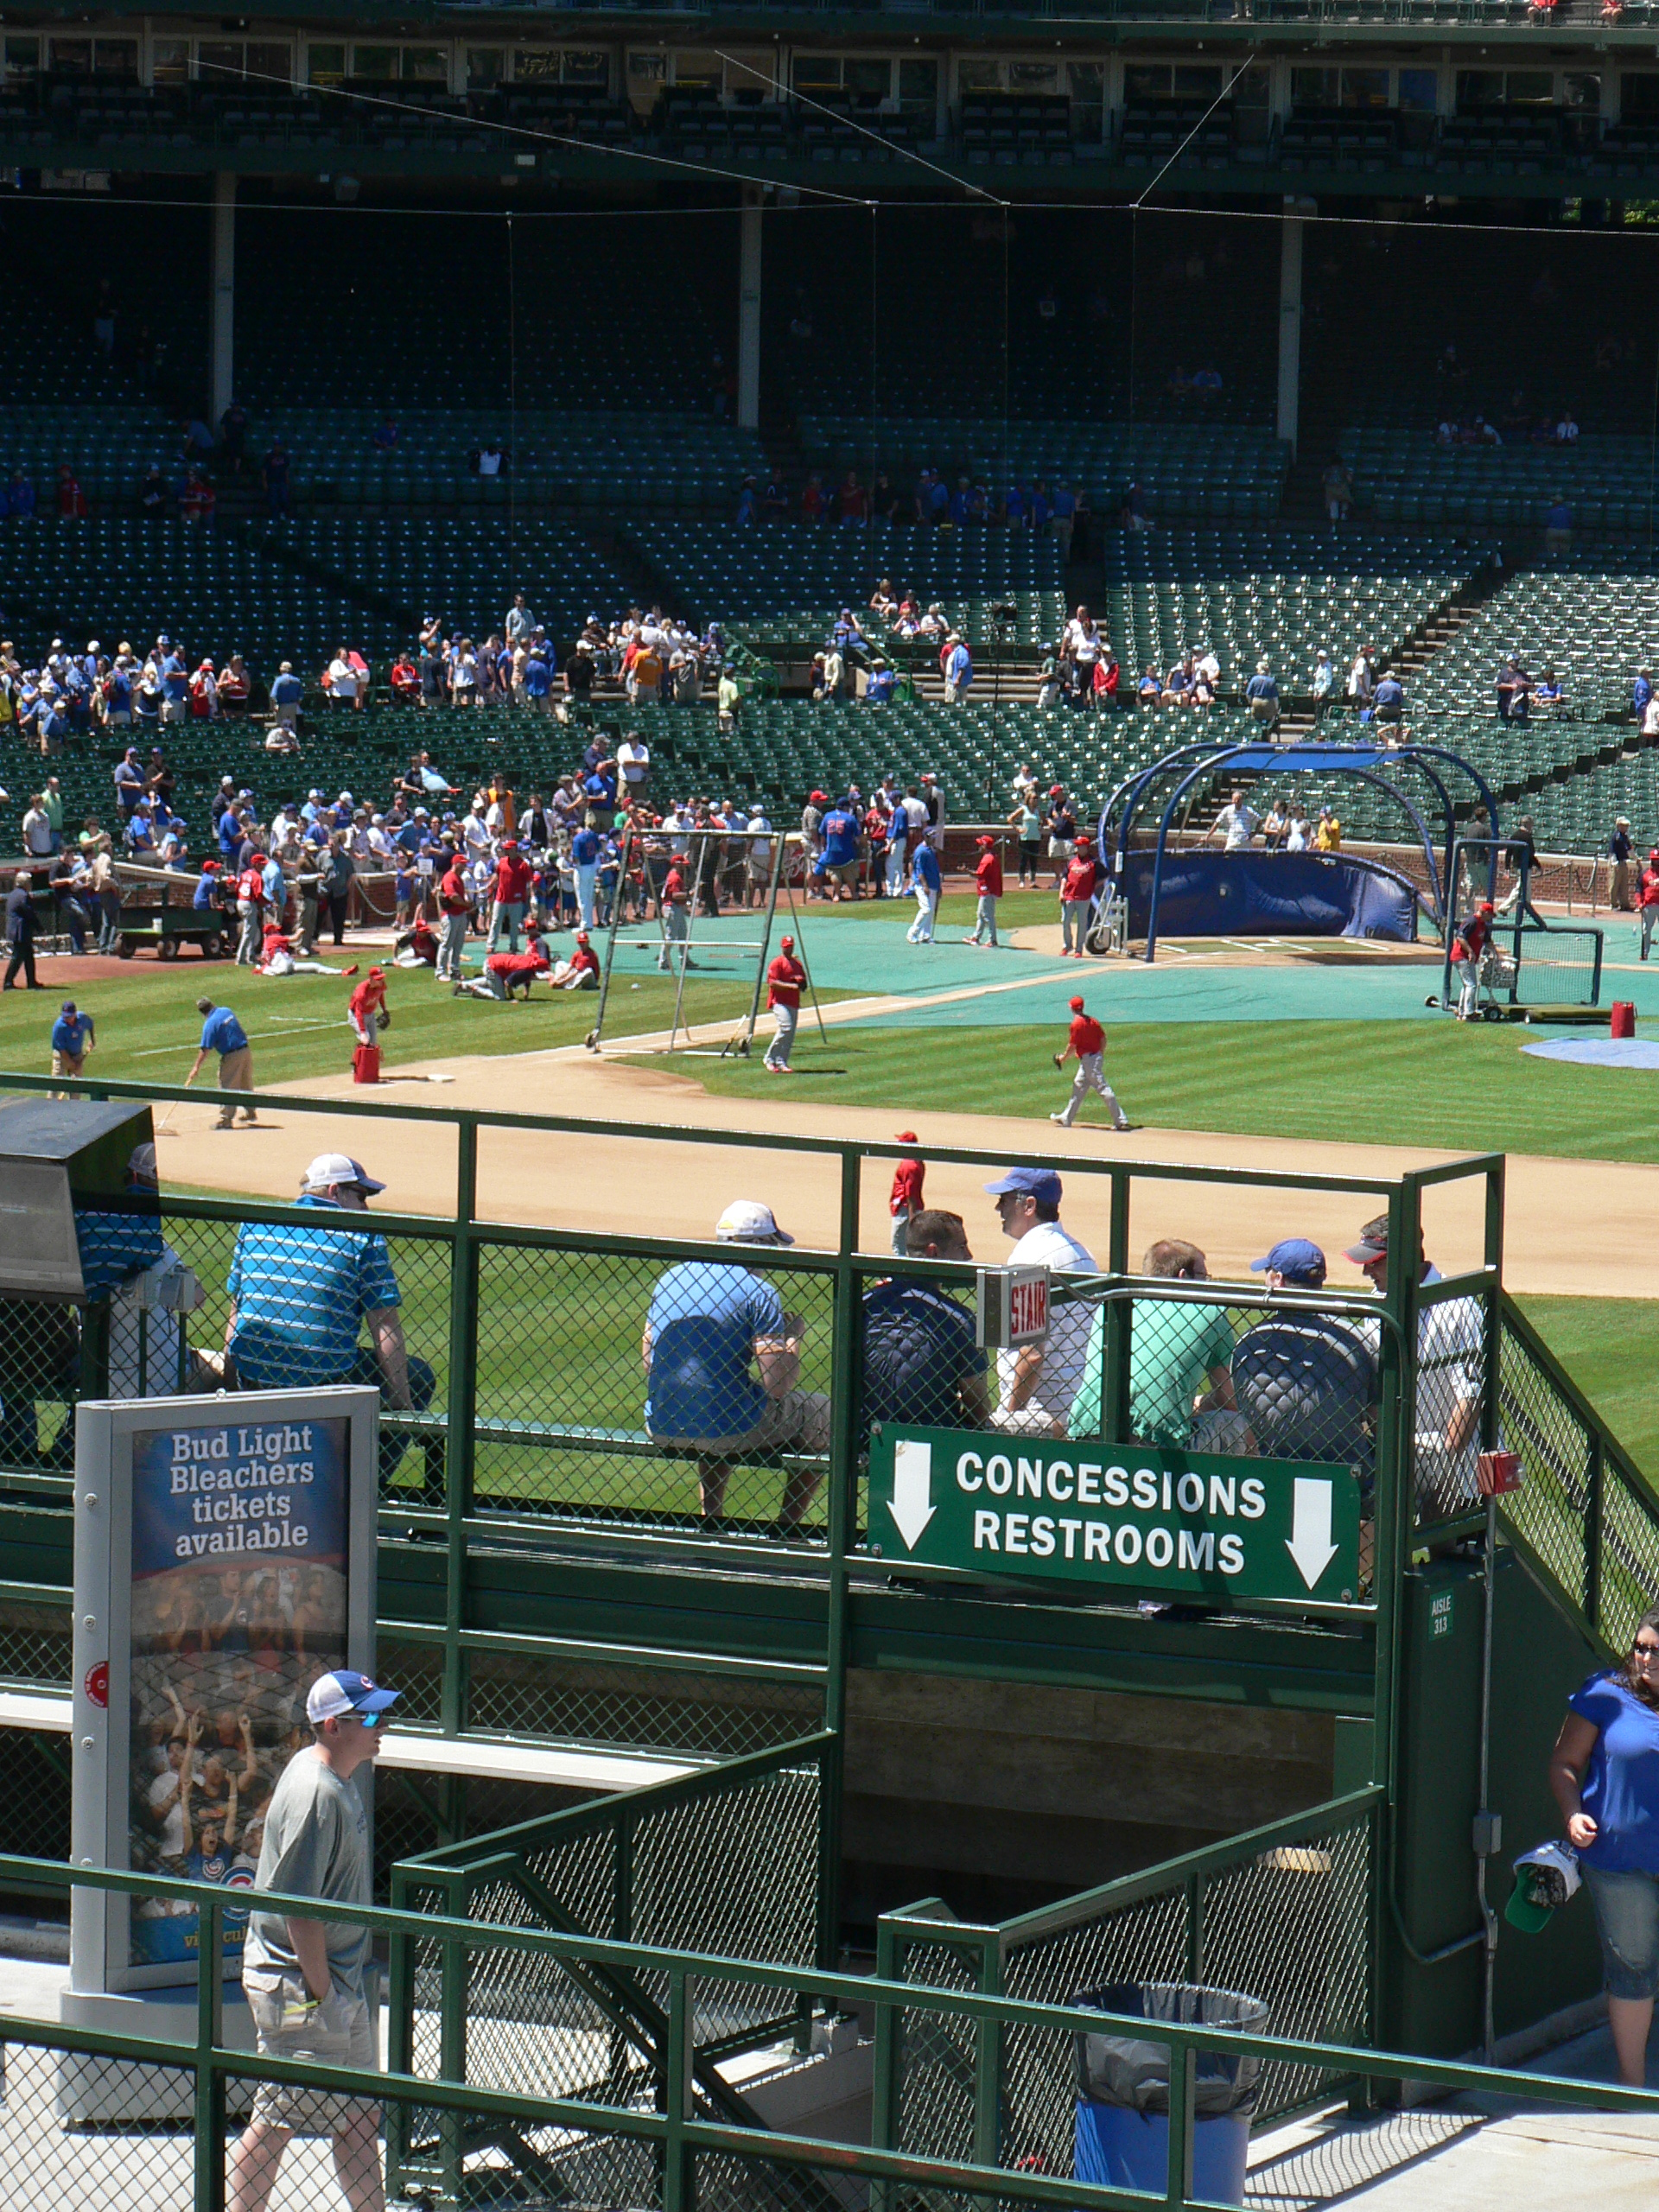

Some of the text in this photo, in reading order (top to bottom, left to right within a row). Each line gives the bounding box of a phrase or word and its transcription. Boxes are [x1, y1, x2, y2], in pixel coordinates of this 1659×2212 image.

[827, 818, 846, 836] 25
[1011, 1280, 1046, 1335] STAIR
[172, 1425, 313, 1462] Bud Light
[169, 1459, 315, 1495] Bleachers
[956, 1451, 1267, 1519] CONCESSIONS
[192, 1491, 291, 1523] tickets
[175, 1519, 308, 1557] available
[974, 1510, 1246, 1575] RESTROOMS
[1432, 1595, 1452, 1618] AISLE
[1434, 1616, 1448, 1635] 313
